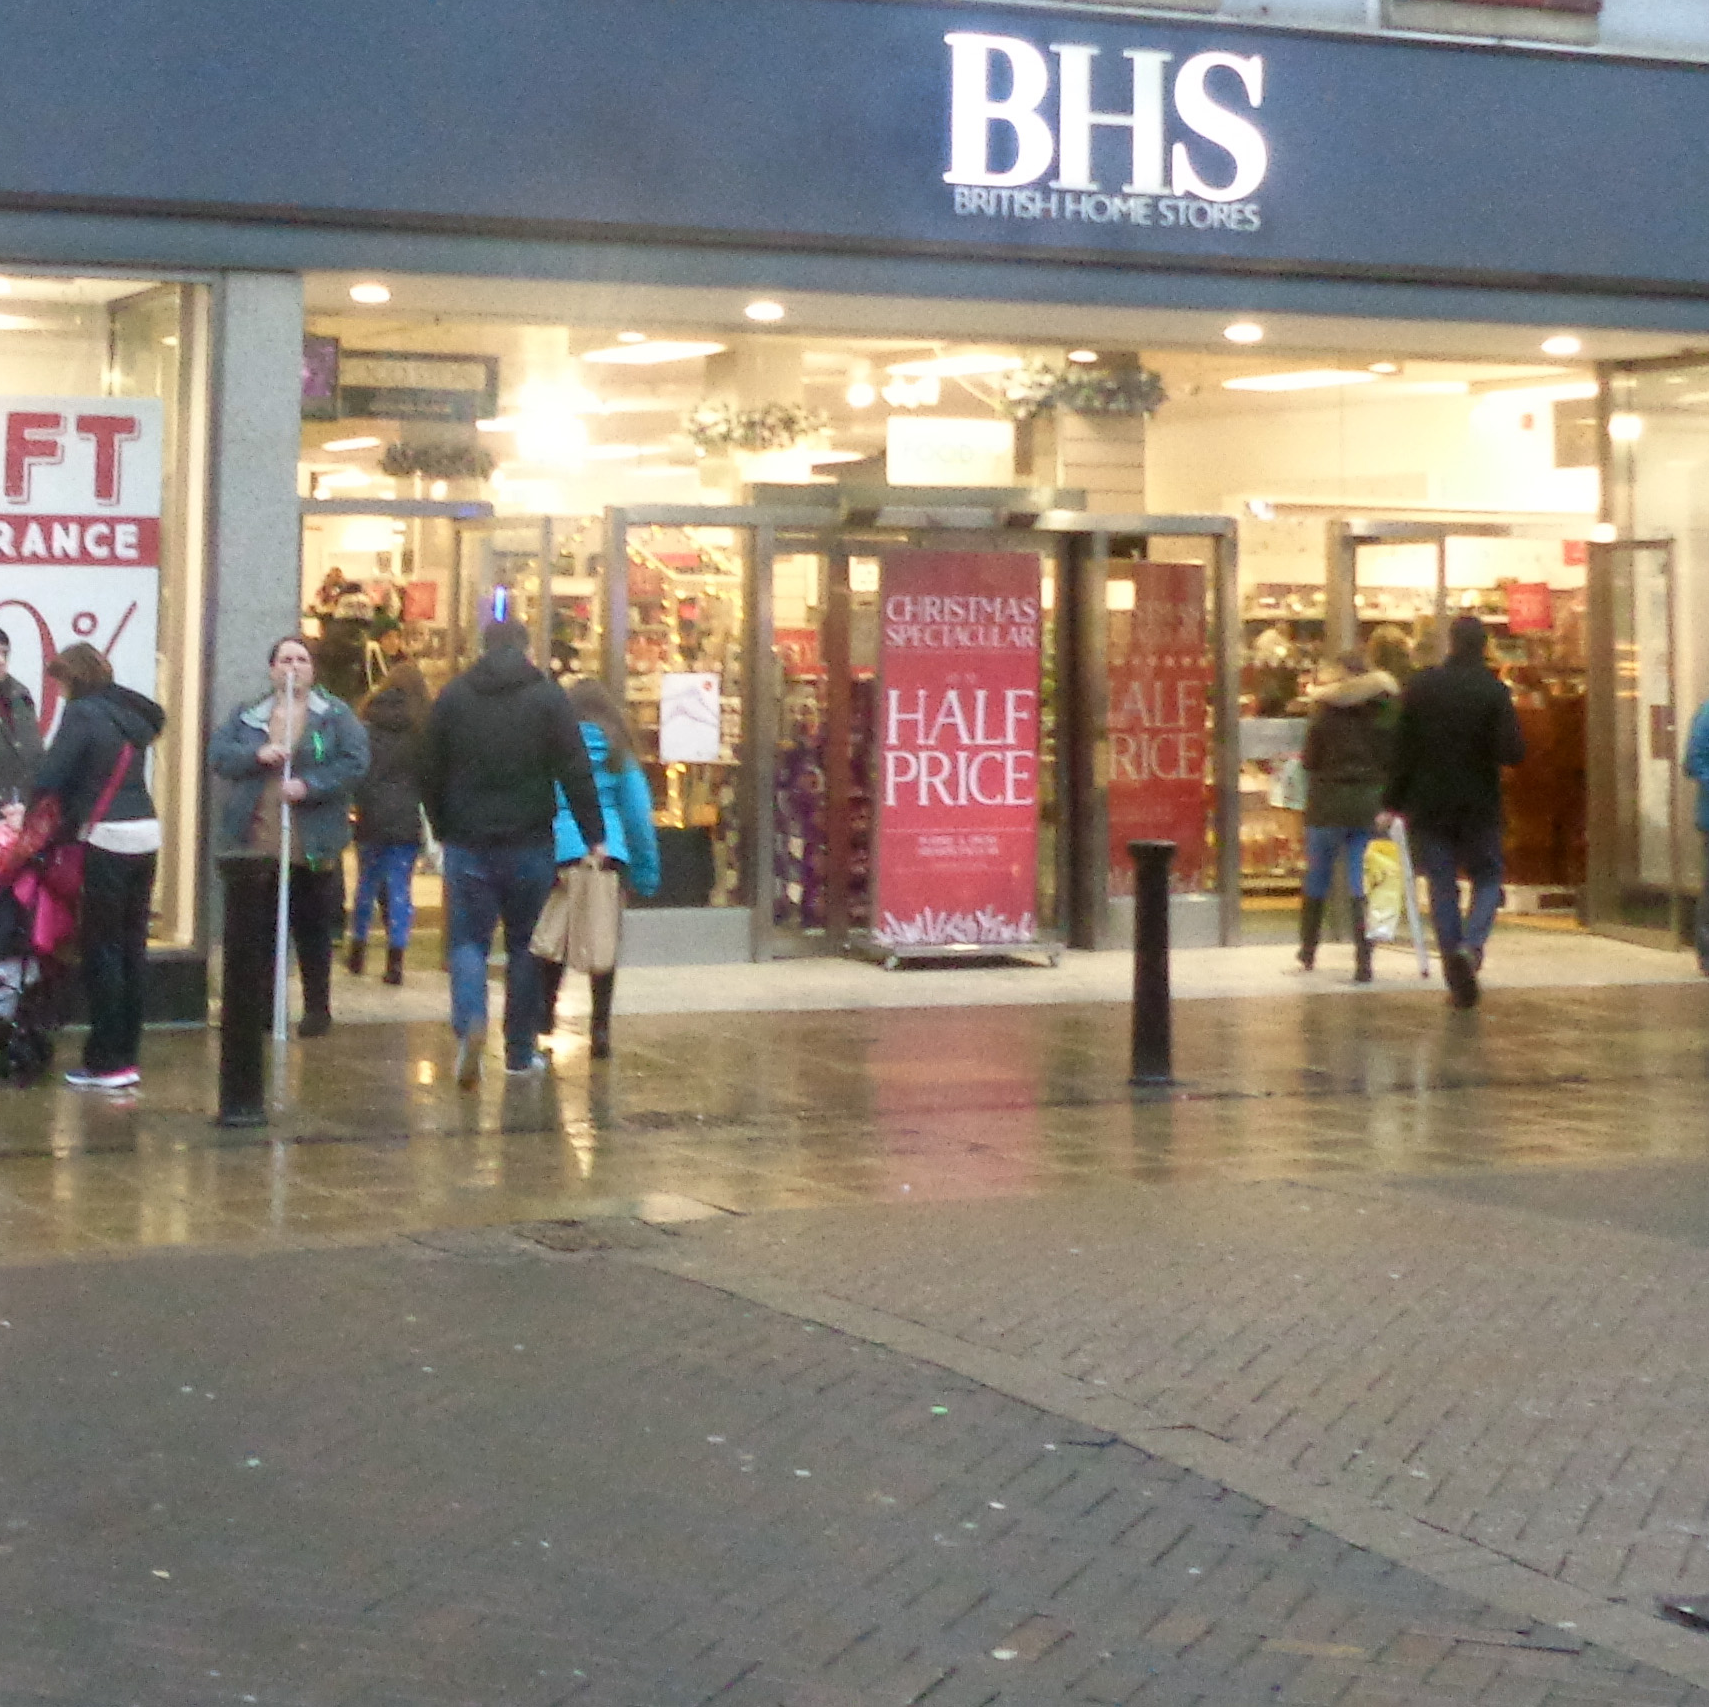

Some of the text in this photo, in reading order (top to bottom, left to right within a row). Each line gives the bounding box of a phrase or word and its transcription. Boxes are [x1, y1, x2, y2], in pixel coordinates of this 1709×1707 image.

[942, 31, 1268, 203] BHS
[954, 186, 1261, 232] BRITISH HOME STORES
[886, 594, 1038, 624] CHRISTMAS
[886, 624, 1036, 648] SPECTACULAR
[886, 688, 1036, 746] HALF
[1108, 680, 1202, 728] ALF
[884, 749, 1034, 807] PRICE
[1108, 733, 1201, 780] RICE
